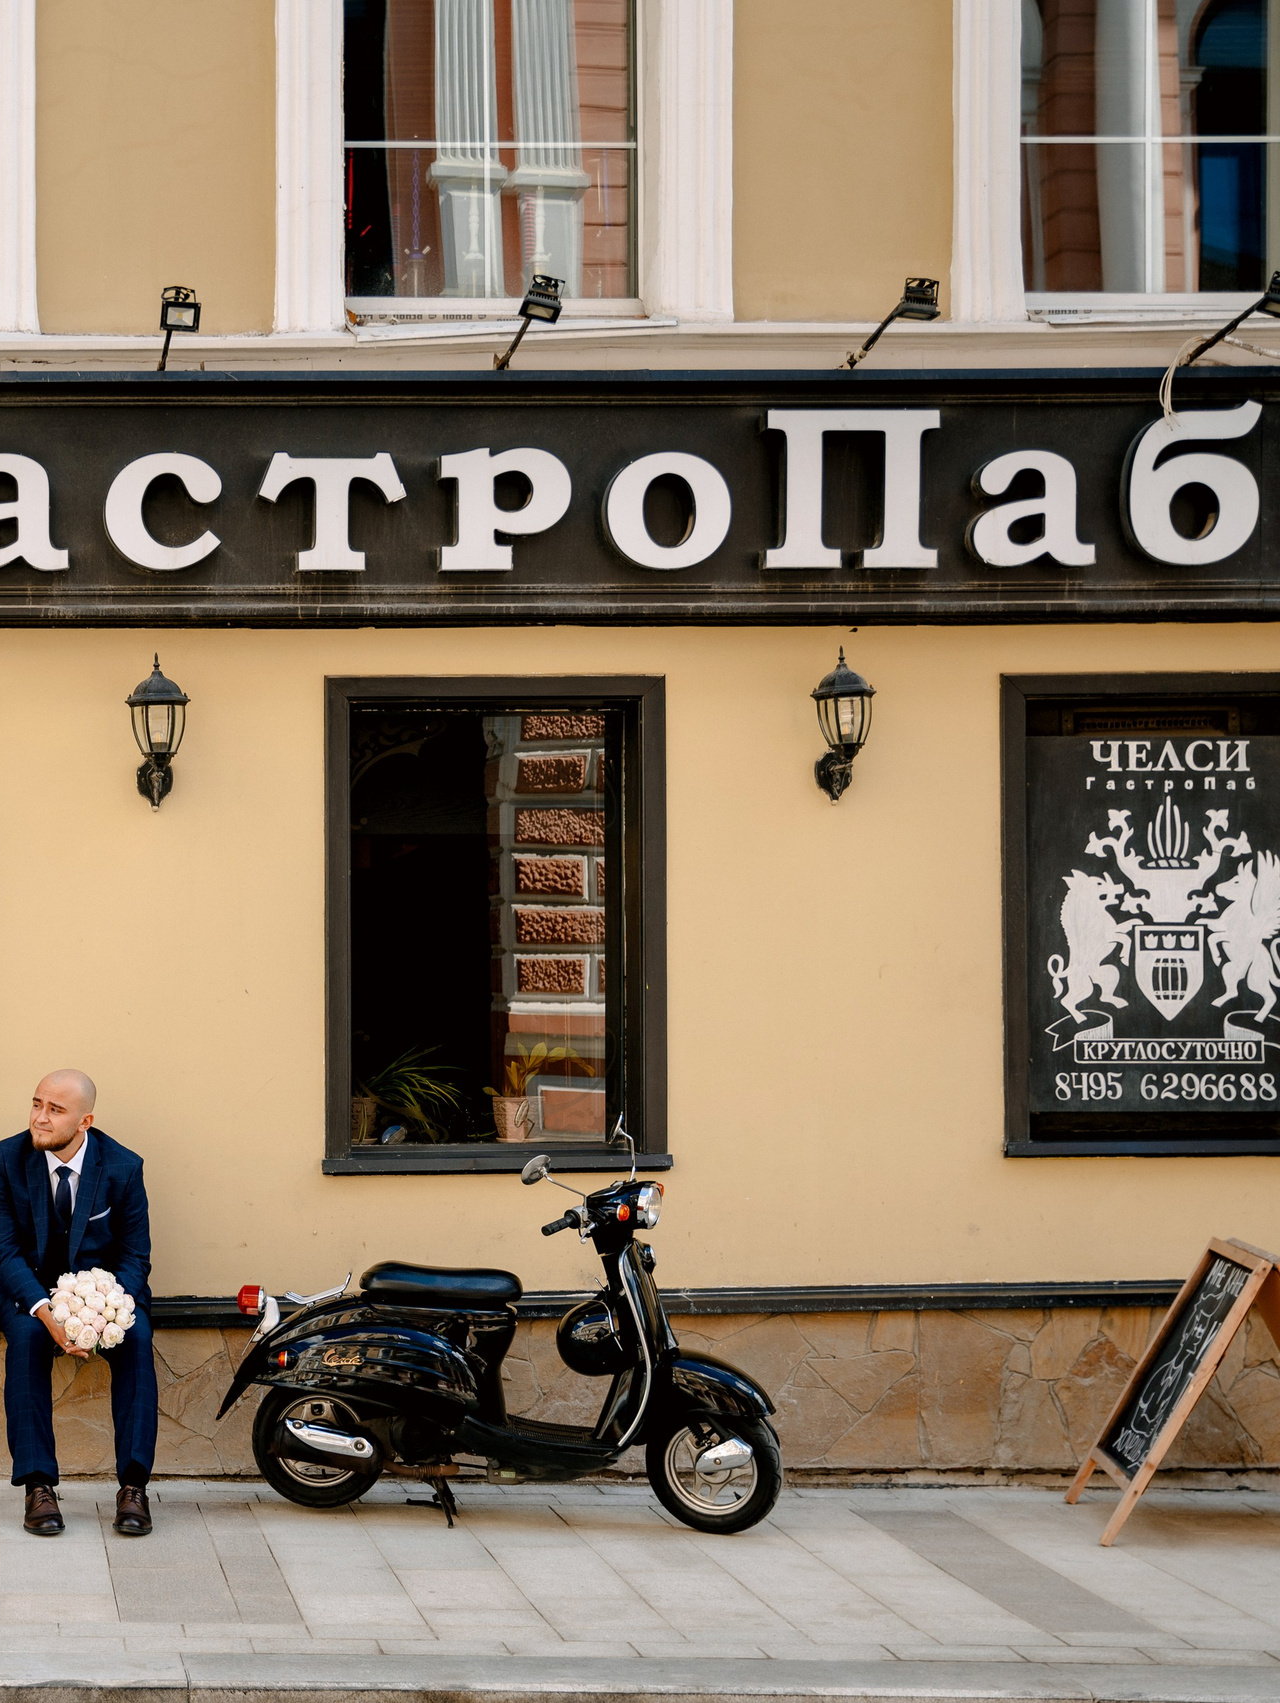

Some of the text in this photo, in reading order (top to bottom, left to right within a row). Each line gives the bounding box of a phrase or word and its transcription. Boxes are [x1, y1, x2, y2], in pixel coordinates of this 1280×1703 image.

[1089, 740, 1251, 772] ЧЕЛСИ
[1085, 776, 1256, 793] ГастроПаб
[1083, 1041, 1257, 1061] КРУГЛОСУТОЧНО
[1055, 1072, 1278, 1102] 8495 6296688
